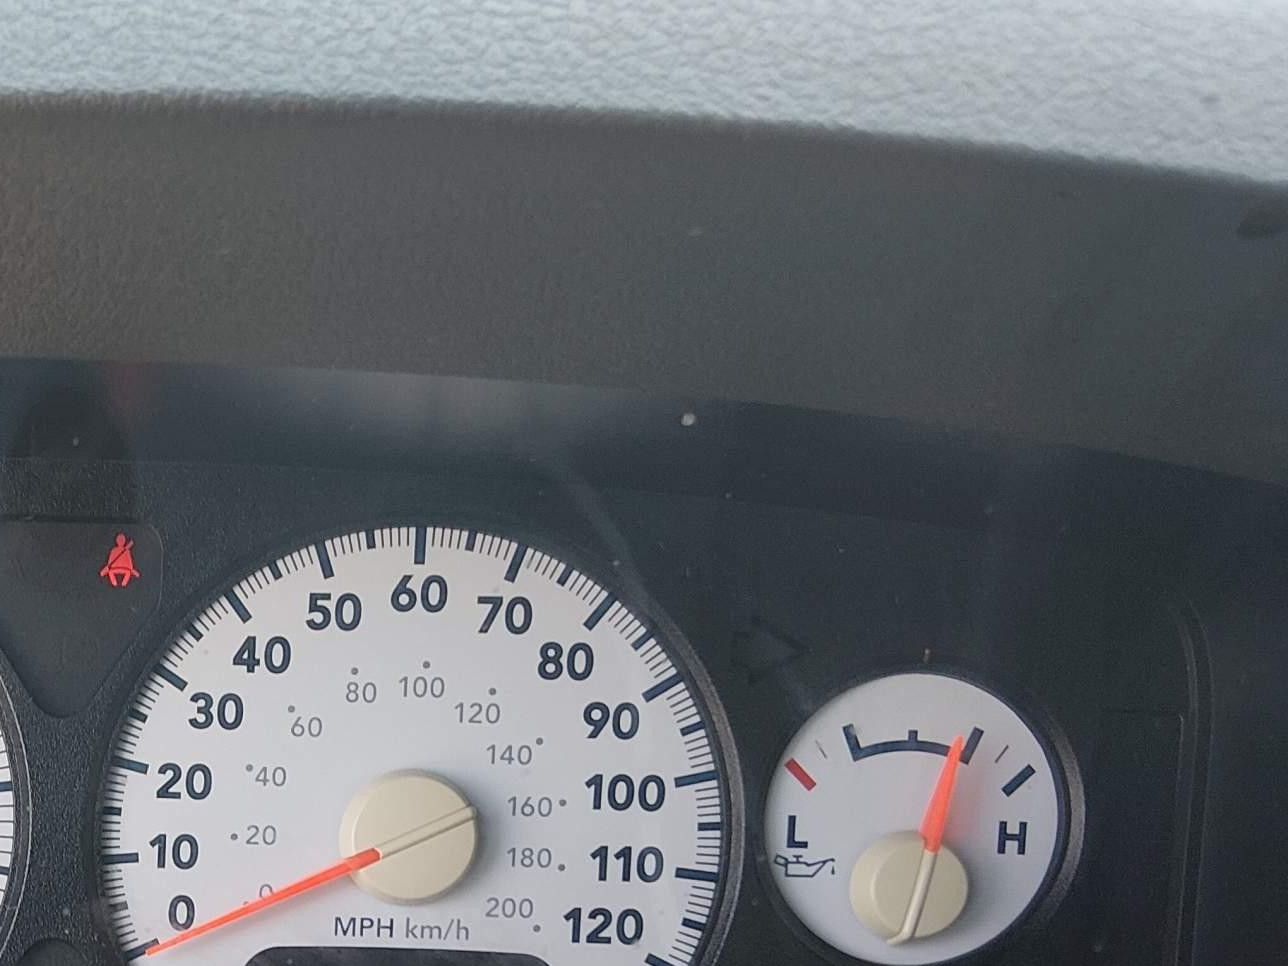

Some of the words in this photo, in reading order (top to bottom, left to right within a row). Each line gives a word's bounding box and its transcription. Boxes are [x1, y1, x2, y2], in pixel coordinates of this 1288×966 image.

[305, 592, 362, 632] 50
[390, 574, 448, 614] 60
[477, 595, 533, 635] 70
[232, 635, 292, 675] 40
[537, 641, 594, 682] 80
[345, 681, 377, 704] 80
[399, 676, 445, 699] 100
[188, 691, 244, 731] 30
[290, 716, 323, 738] 60
[454, 702, 501, 725] 120
[583, 701, 640, 741] 90
[486, 744, 533, 766] 140
[156, 762, 213, 801] 20
[255, 766, 287, 787] 40
[584, 773, 666, 813] 100
[507, 795, 553, 818] 160
[245, 824, 277, 846] 20
[786, 814, 809, 849] L
[996, 820, 1028, 856] H
[149, 833, 199, 870] 10
[506, 847, 552, 869] 180
[589, 845, 664, 883] 110
[168, 894, 196, 932] 0
[485, 897, 534, 919] 200
[334, 916, 394, 939] MPH
[405, 917, 470, 941] km/h
[563, 907, 644, 946] 120
